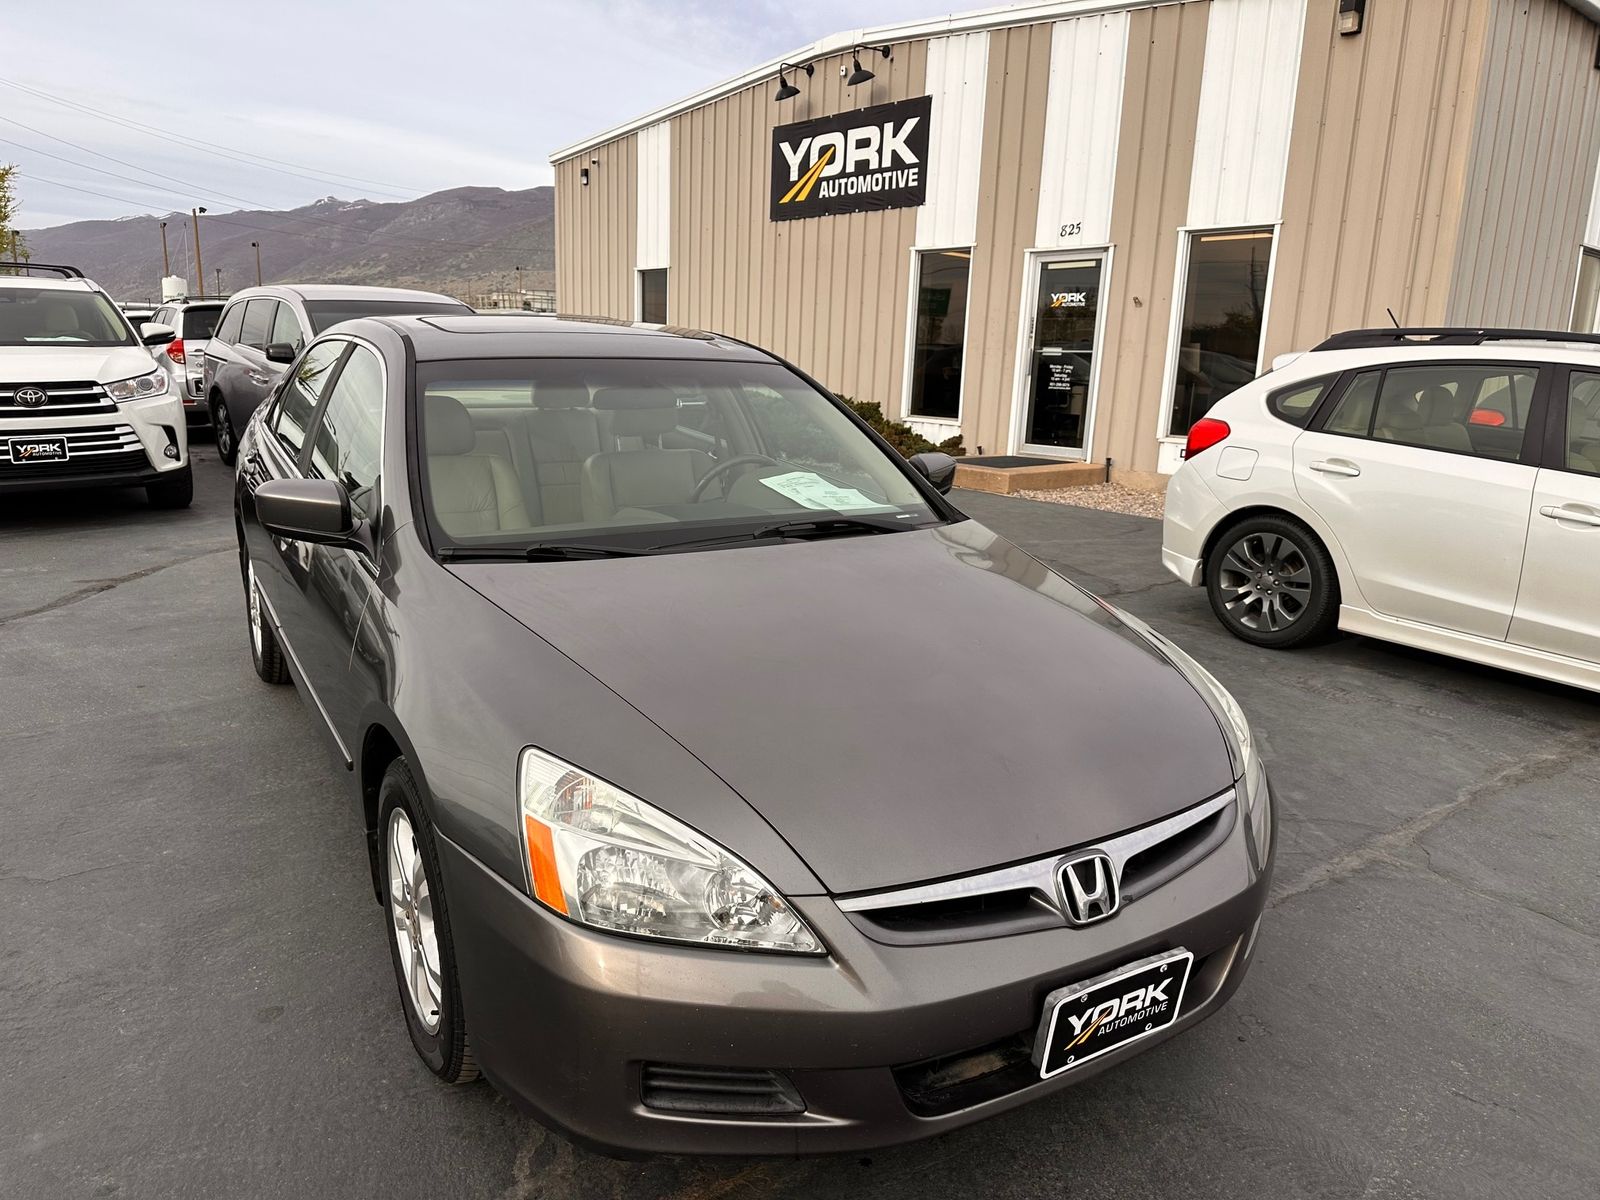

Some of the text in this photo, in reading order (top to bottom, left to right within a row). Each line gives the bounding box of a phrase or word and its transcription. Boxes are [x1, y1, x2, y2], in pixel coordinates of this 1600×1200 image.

[779, 117, 920, 182] YORK
[819, 167, 919, 198] AUTOMOTIVE
[1060, 222, 1082, 237] 825
[1051, 292, 1086, 302] YORK
[16, 443, 61, 453] YORK
[1067, 977, 1173, 1036] YORK
[1097, 1001, 1168, 1036] AUTOMOTIVE
